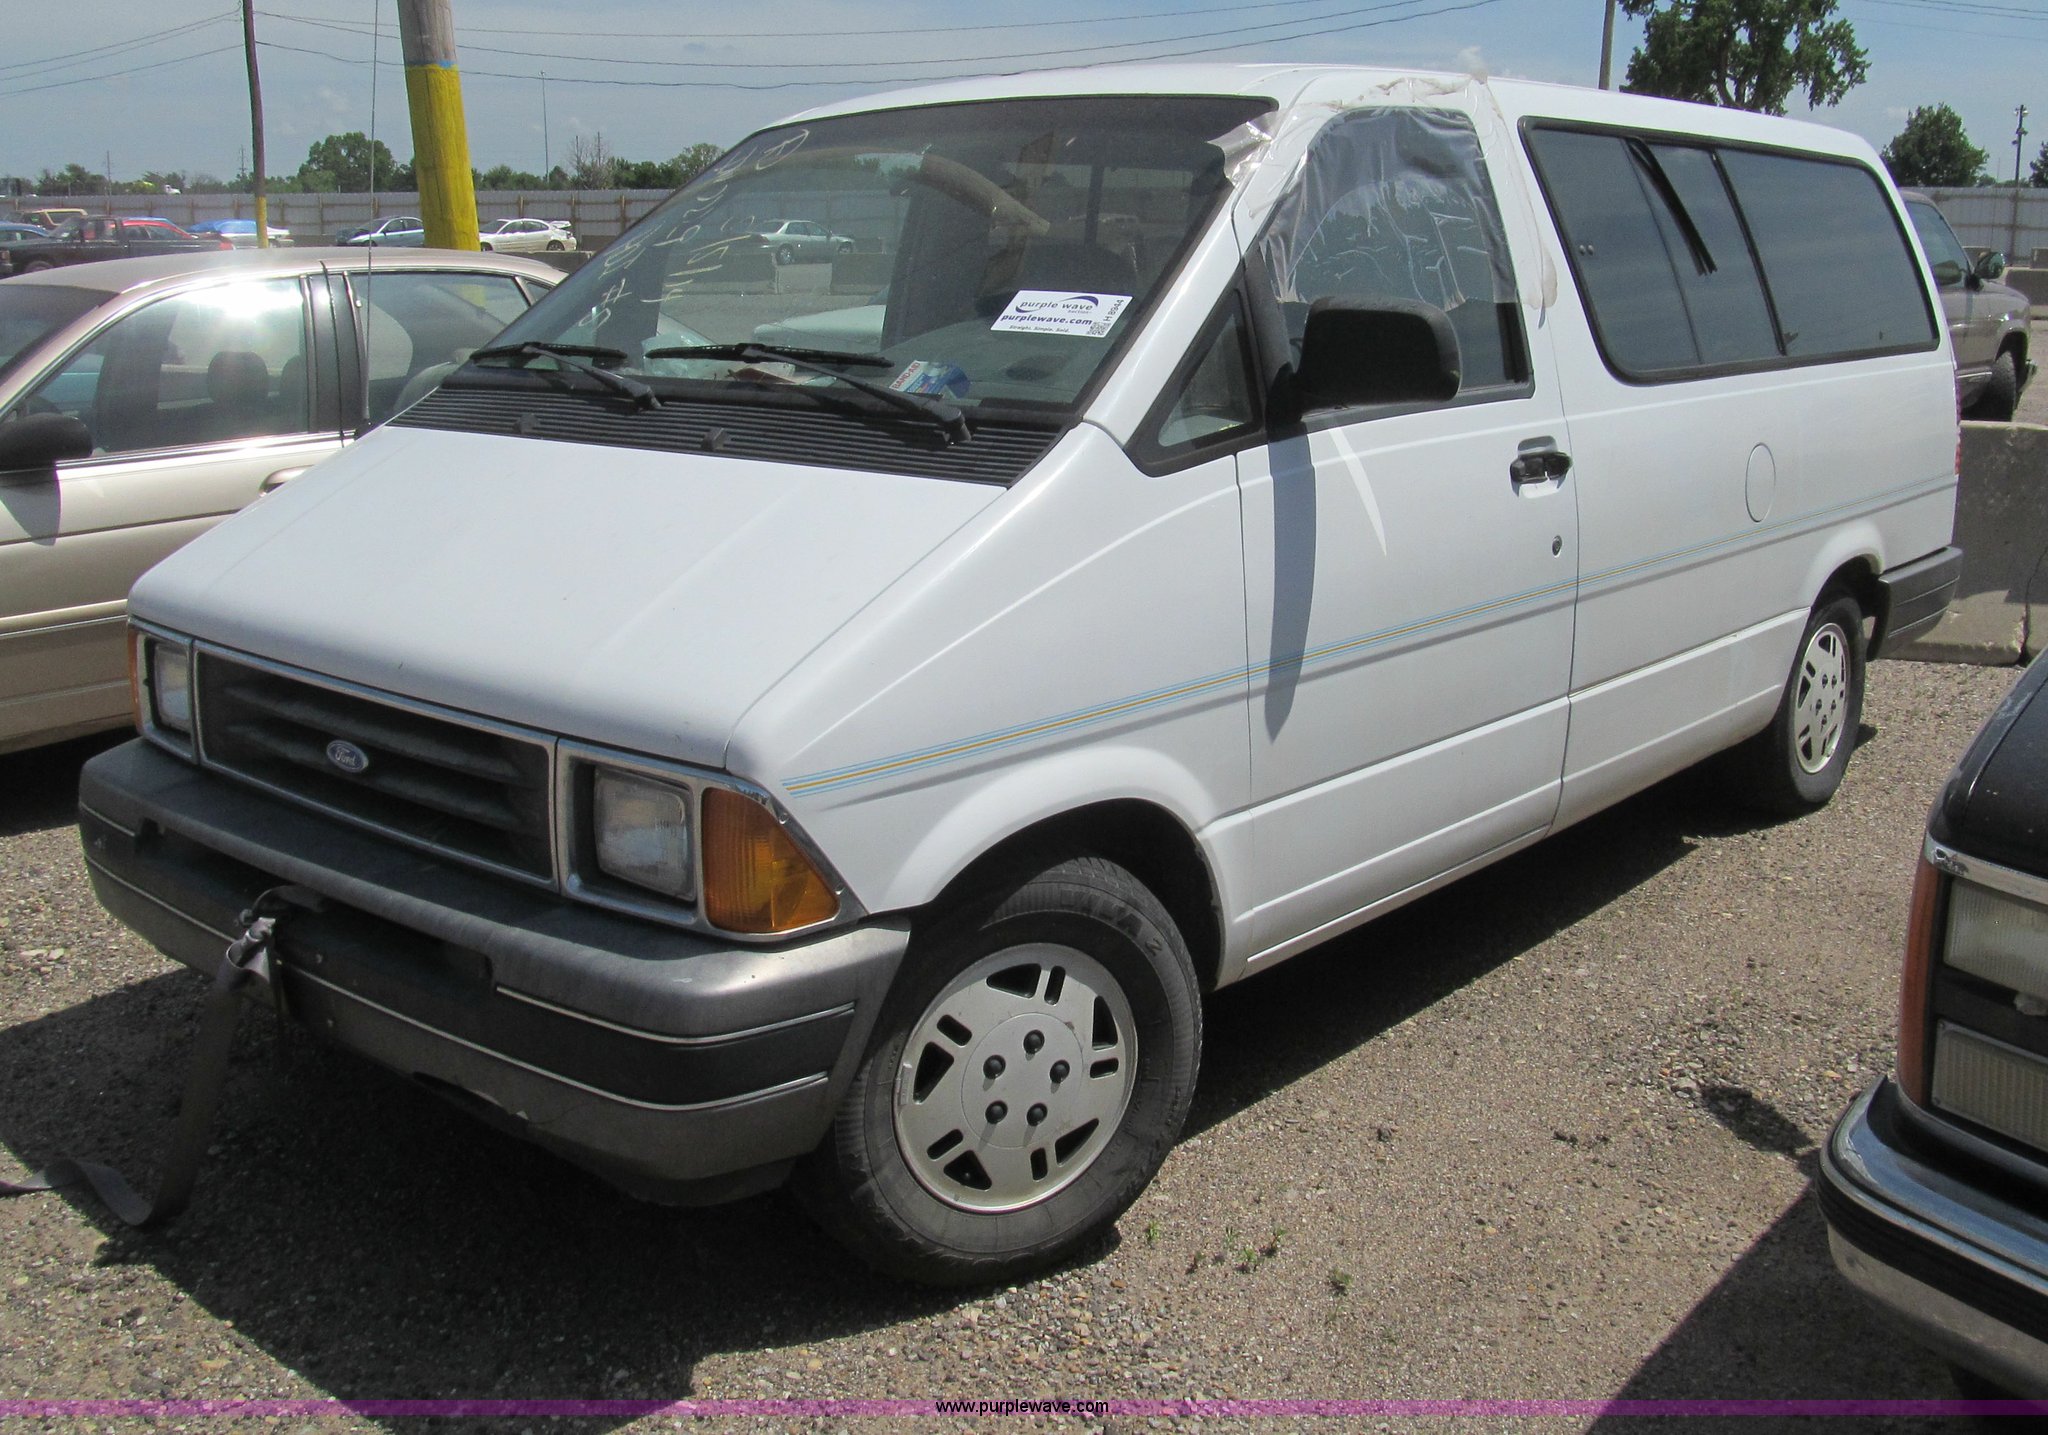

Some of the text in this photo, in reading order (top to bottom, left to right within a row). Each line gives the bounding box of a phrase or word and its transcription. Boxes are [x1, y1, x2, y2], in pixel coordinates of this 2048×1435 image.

[1020, 301, 1093, 311] purple wave
[1001, 314, 1092, 326] purplewave.com
[891, 362, 920, 389] BAND-AID
